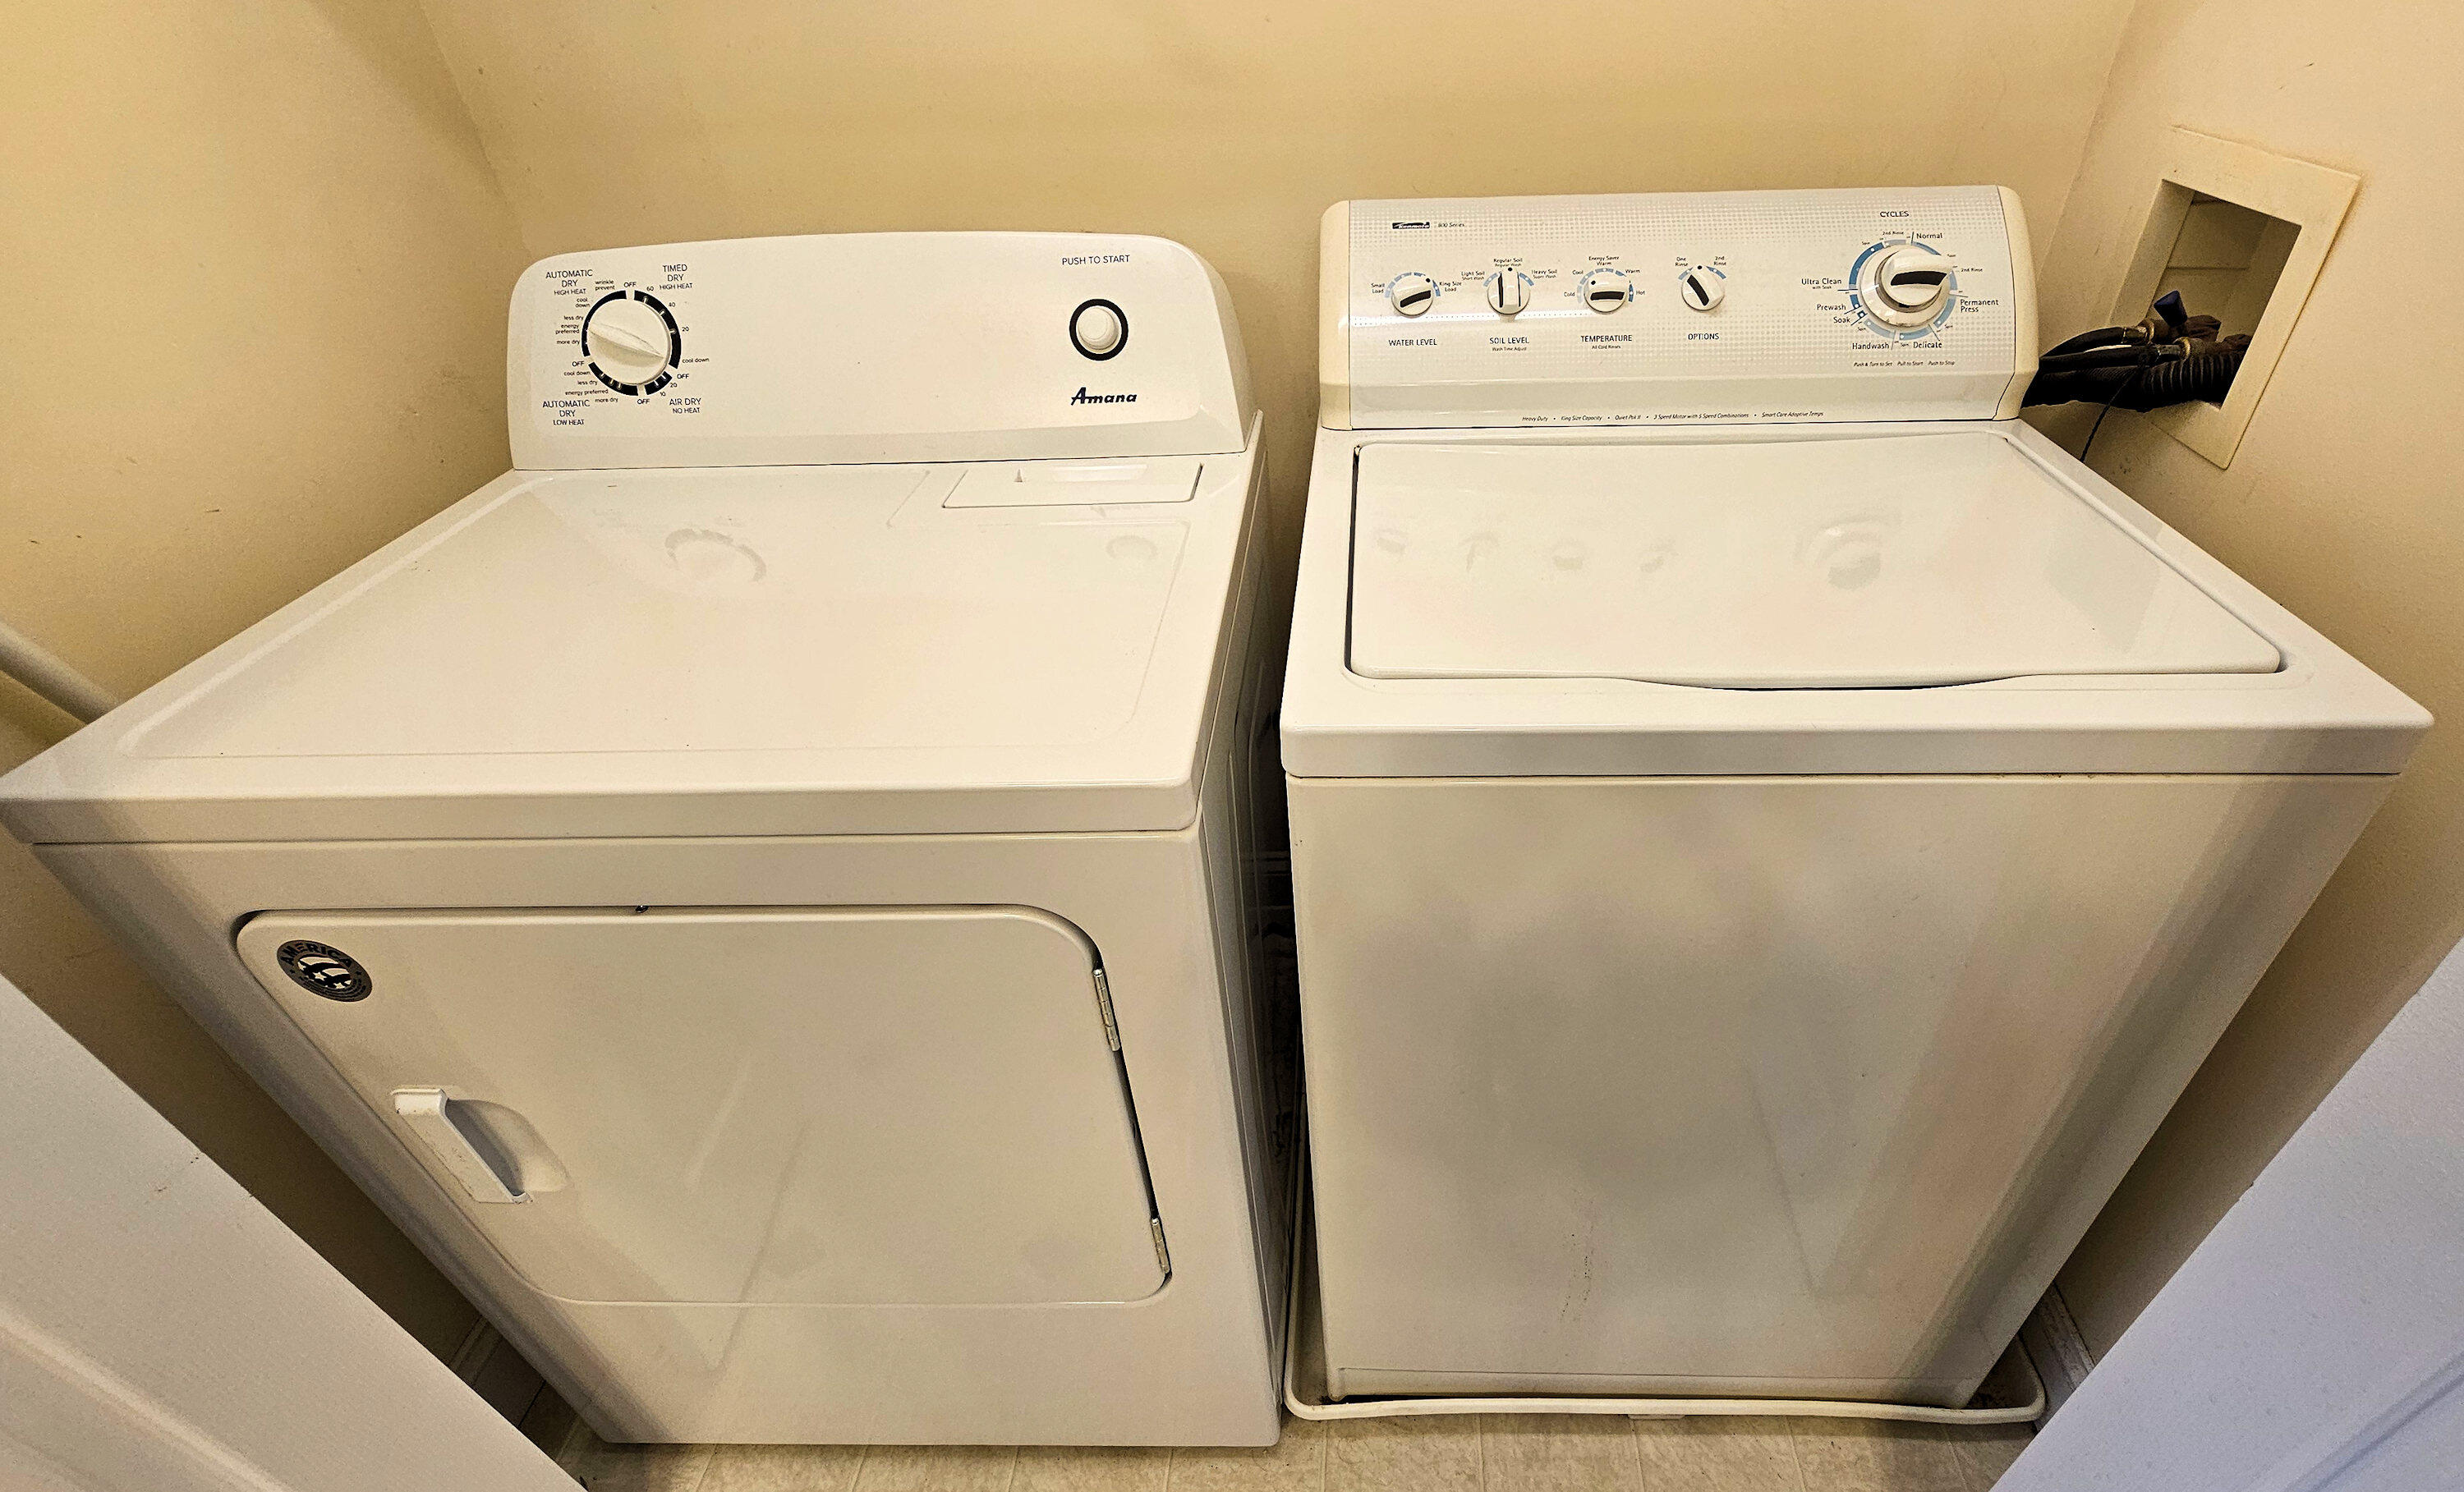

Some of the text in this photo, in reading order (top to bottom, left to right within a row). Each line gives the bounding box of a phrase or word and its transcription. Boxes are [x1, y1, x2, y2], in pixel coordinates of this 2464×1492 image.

[1062, 255, 1130, 265] PUSH TO START
[663, 264, 687, 273] TIMED
[545, 269, 593, 279] AUTOMATIC
[667, 273, 684, 282] DRY
[562, 280, 578, 288] DRY
[1817, 303, 1846, 311] Prewash
[1580, 334, 1633, 342] TEMPERATURE
[1913, 341, 1942, 349] Delicate
[1071, 387, 1138, 406] Amana
[542, 400, 591, 408] AUTOMATIC
[669, 397, 701, 406] AIR DRY
[281, 941, 352, 969] AMERICA
